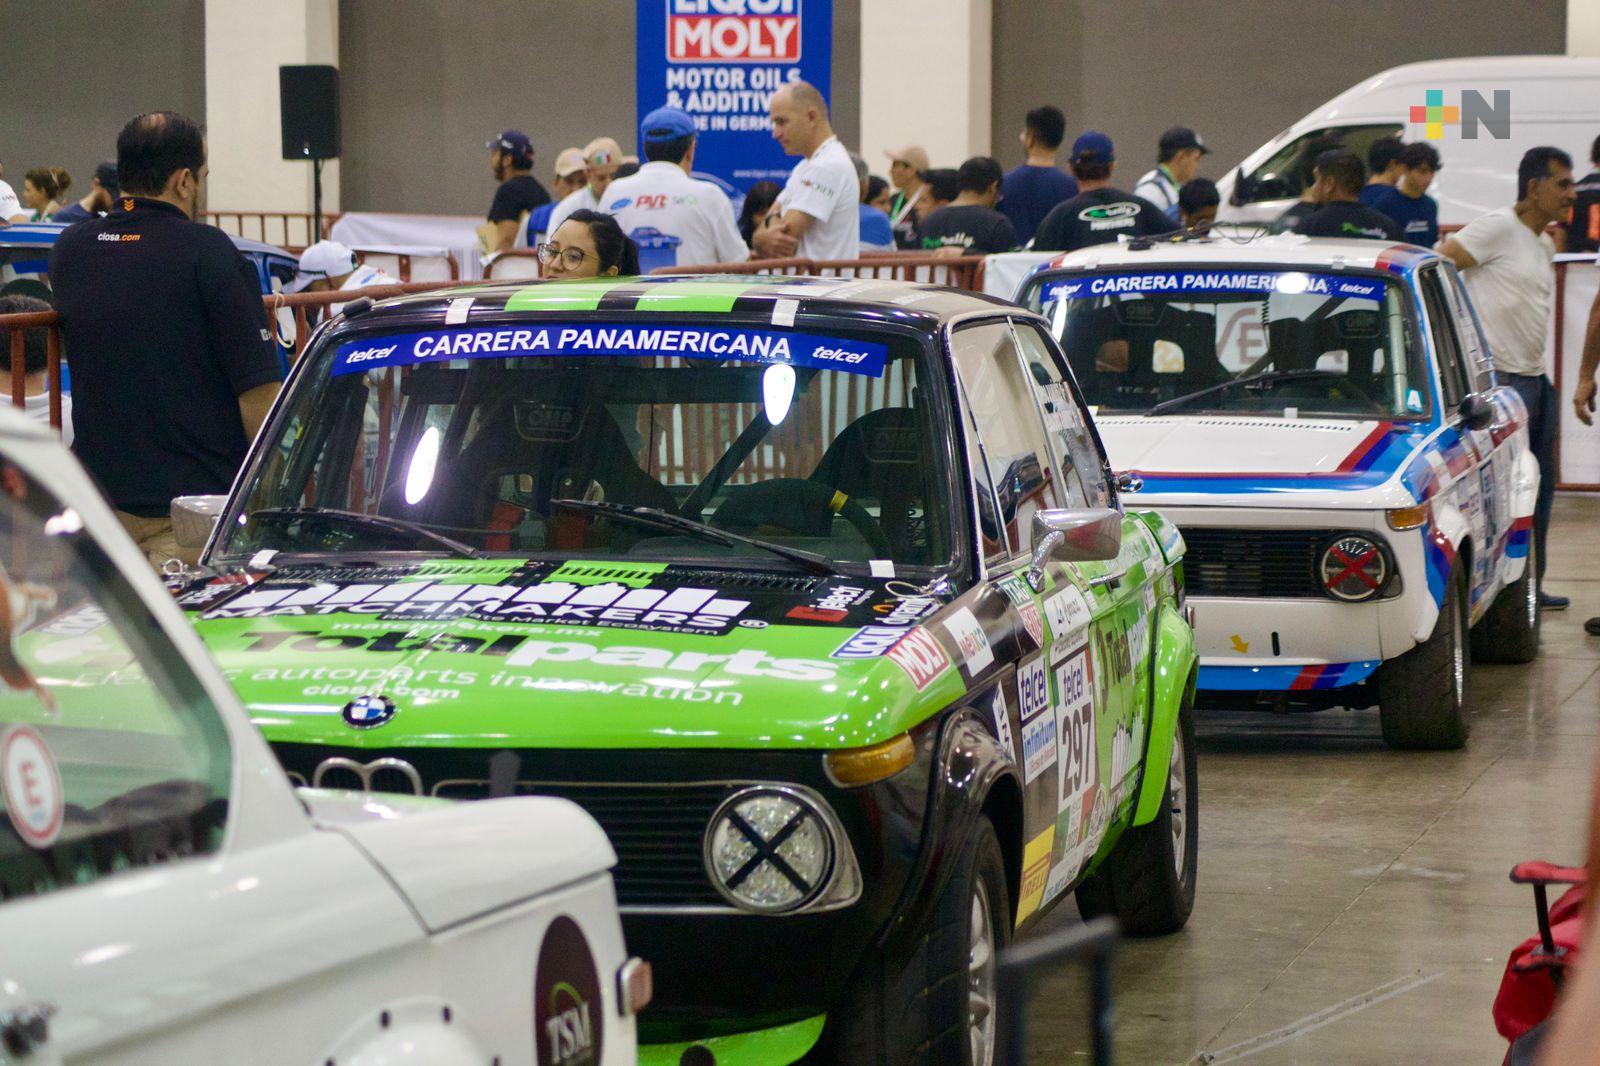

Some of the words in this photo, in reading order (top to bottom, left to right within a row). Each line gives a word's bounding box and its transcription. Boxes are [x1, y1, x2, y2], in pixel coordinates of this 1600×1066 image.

[674, 17, 798, 58] MOLY
[666, 67, 745, 90] MOTOR
[711, 115, 728, 131] IN
[1090, 275, 1179, 294] CARRERA
[1181, 273, 1328, 293] PANAMERINA
[1339, 282, 1375, 296] telcel
[345, 344, 398, 364] telcel
[413, 328, 550, 358] CARRERA
[557, 328, 792, 359] PANAMERICANA
[812, 345, 868, 365] telcel
[202, 600, 731, 628] MATCHMAKERS
[511, 614, 590, 627] Market
[597, 620, 719, 636] Ecosystem
[888, 628, 946, 688] MOLY
[1021, 656, 1047, 715] telcel
[1063, 657, 1084, 708] telcel
[1062, 701, 1092, 801] 297
